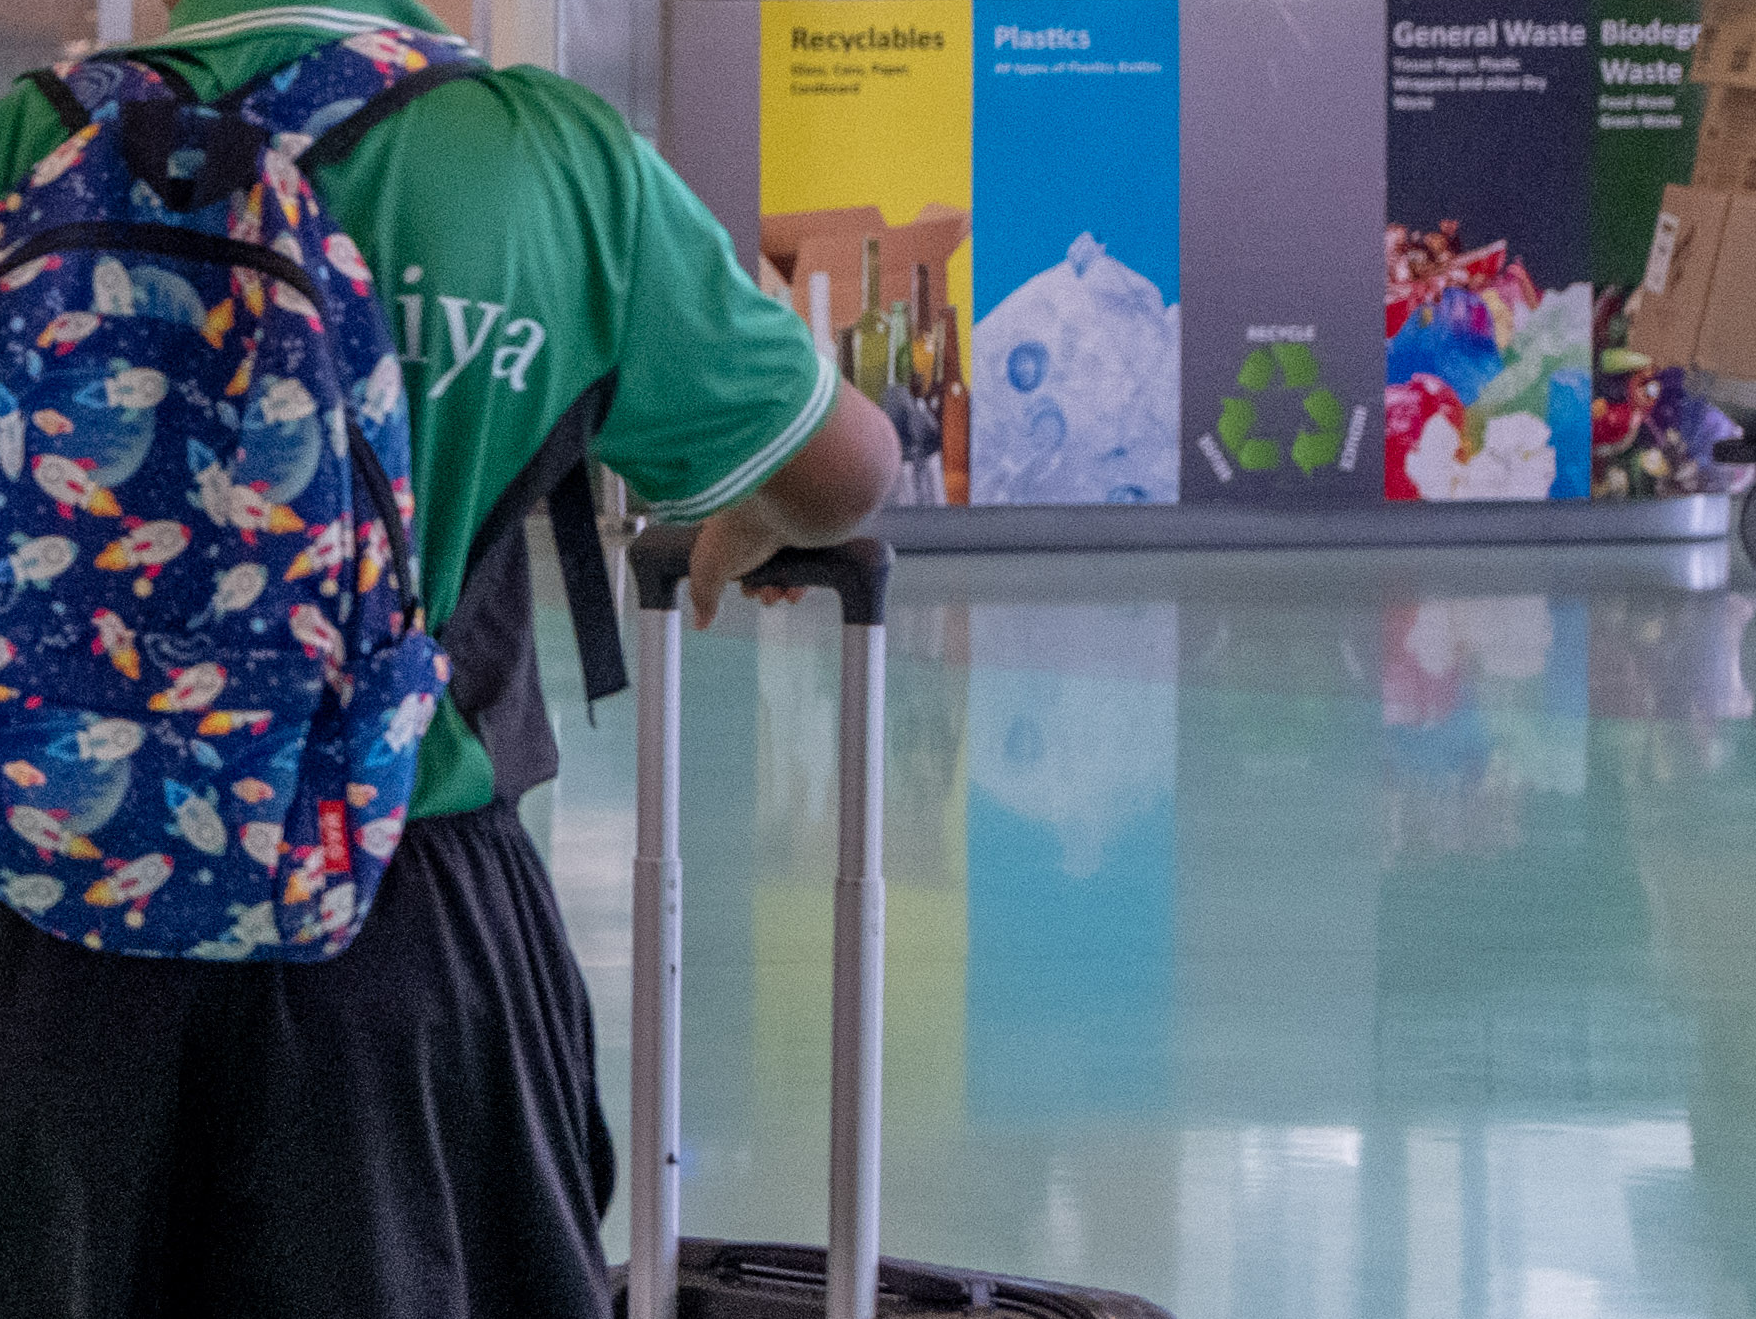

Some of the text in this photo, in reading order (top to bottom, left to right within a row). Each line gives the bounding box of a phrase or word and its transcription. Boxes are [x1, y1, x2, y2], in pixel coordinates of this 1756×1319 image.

[791, 25, 945, 52] Recyclables
[993, 25, 1091, 50] Plastics
[1393, 19, 1587, 48] General Waste
[1601, 19, 1702, 50] Biodegr
[1600, 58, 1684, 85] Waste
[396, 265, 547, 401] iya
